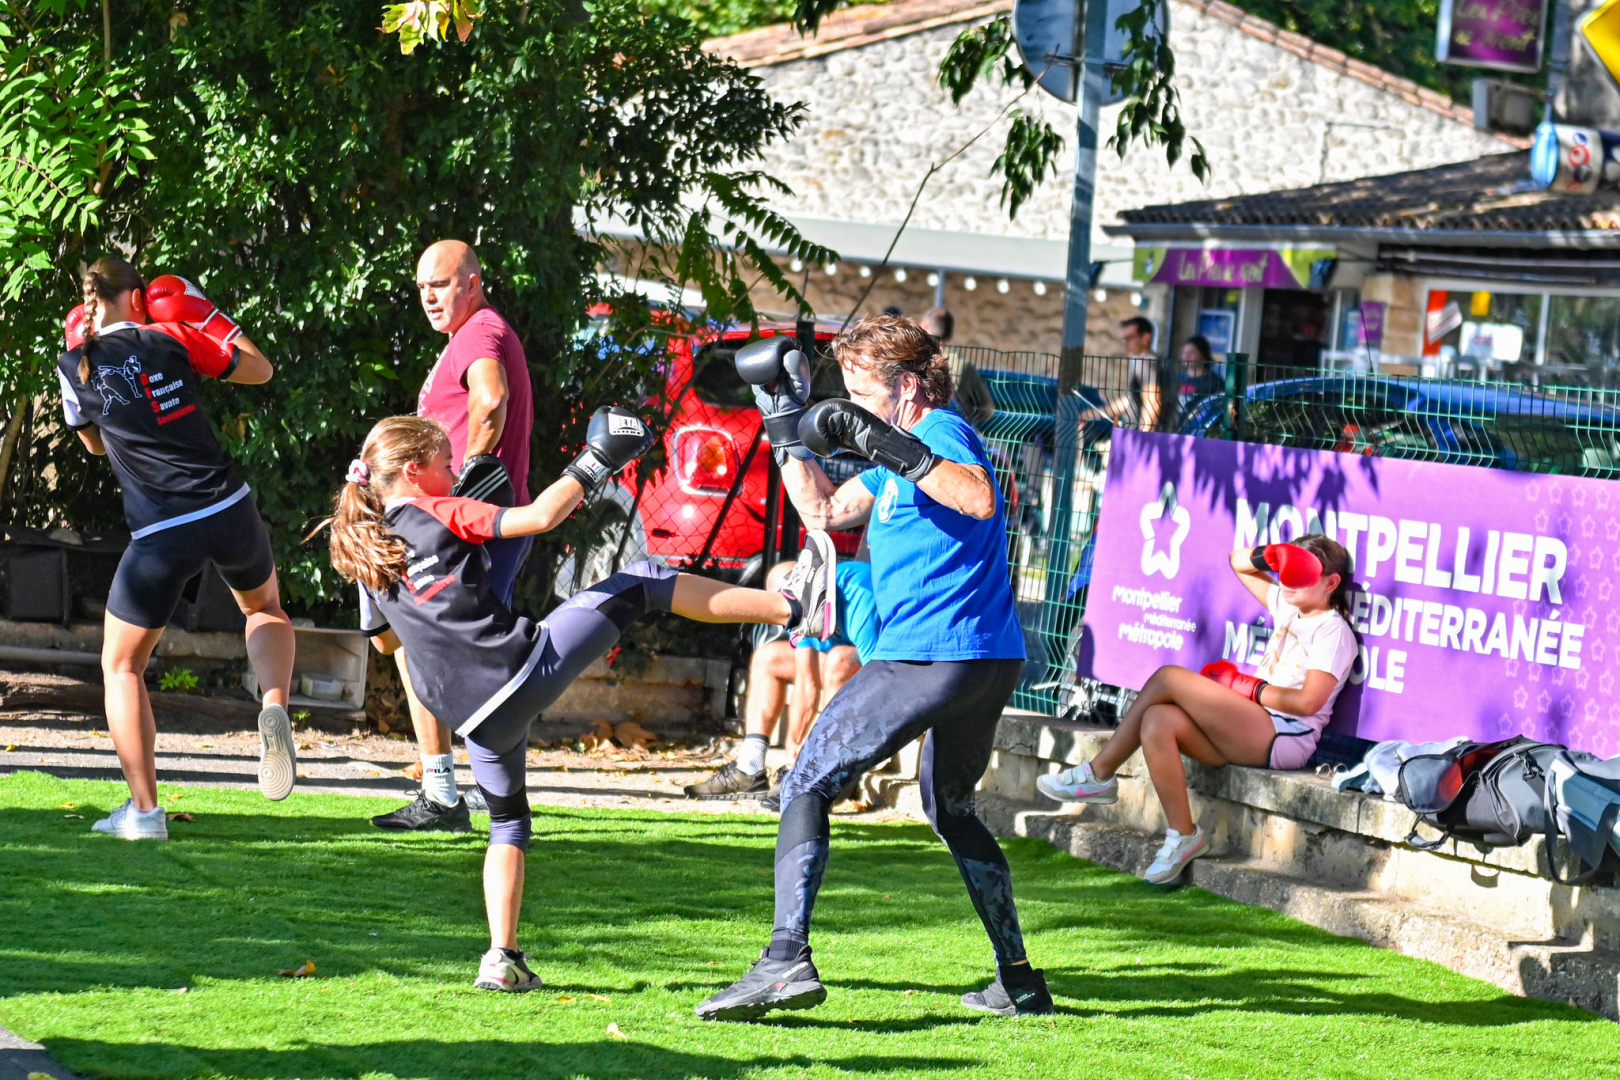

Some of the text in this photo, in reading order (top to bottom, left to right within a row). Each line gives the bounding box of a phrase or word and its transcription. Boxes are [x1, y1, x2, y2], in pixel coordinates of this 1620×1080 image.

[140, 373, 164, 386] Boxe
[144, 379, 184, 399] Française
[151, 397, 180, 413] Savate
[1112, 585, 1183, 614] Montpellier
[1118, 621, 1184, 651] Métropole
[1346, 581, 1586, 670] ÉDITERRANÉE
